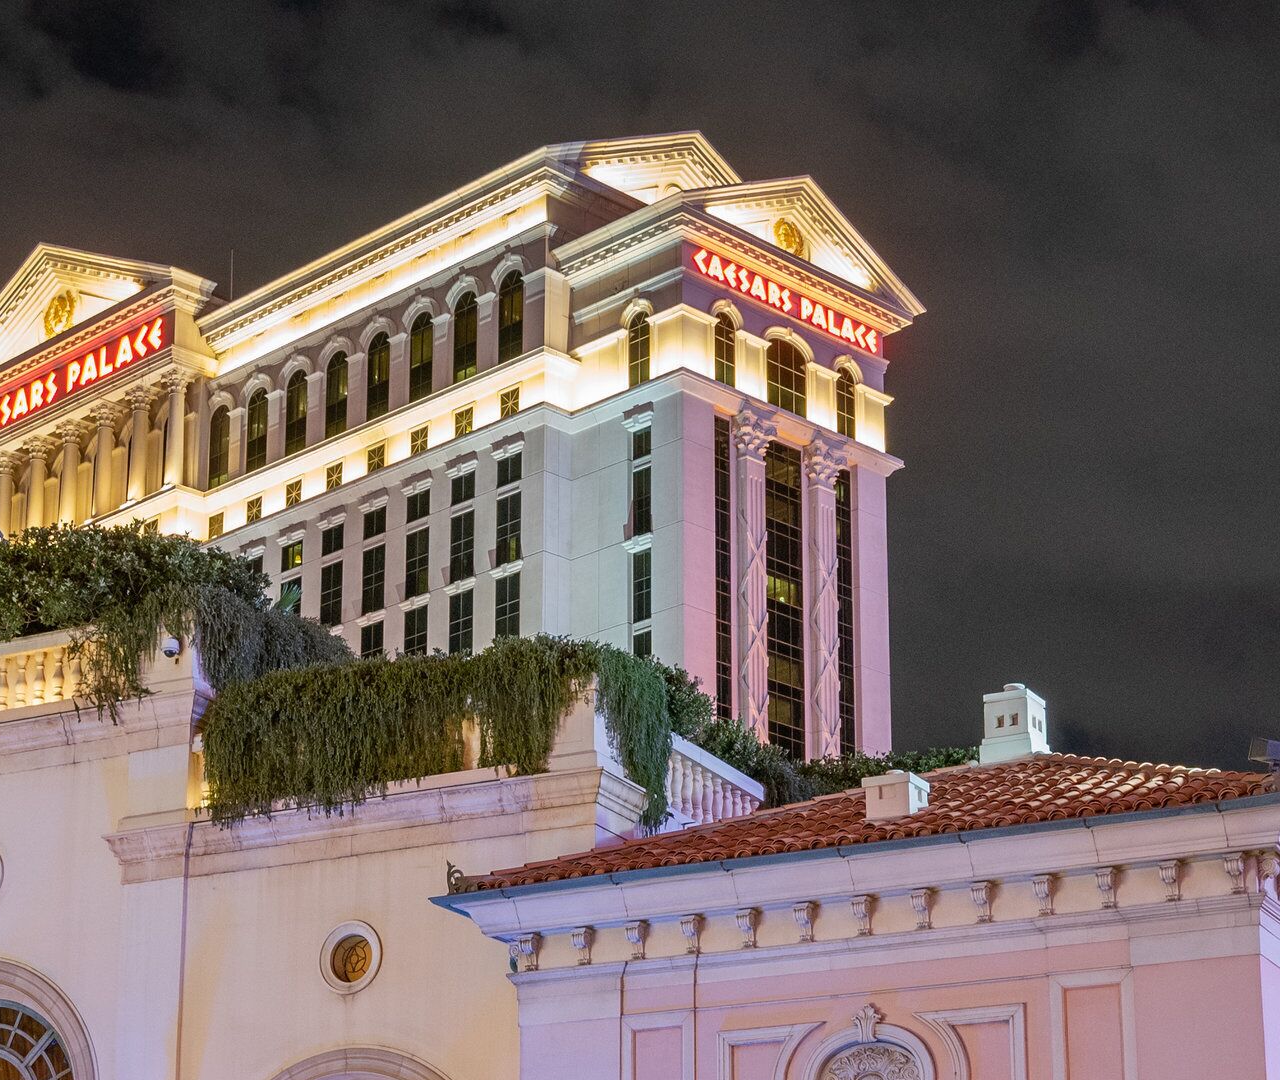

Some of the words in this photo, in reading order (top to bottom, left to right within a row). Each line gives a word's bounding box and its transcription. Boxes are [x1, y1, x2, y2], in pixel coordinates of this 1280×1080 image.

[693, 248, 792, 312] CAESARS
[800, 296, 878, 354] PALACE
[65, 317, 163, 393] PALACE
